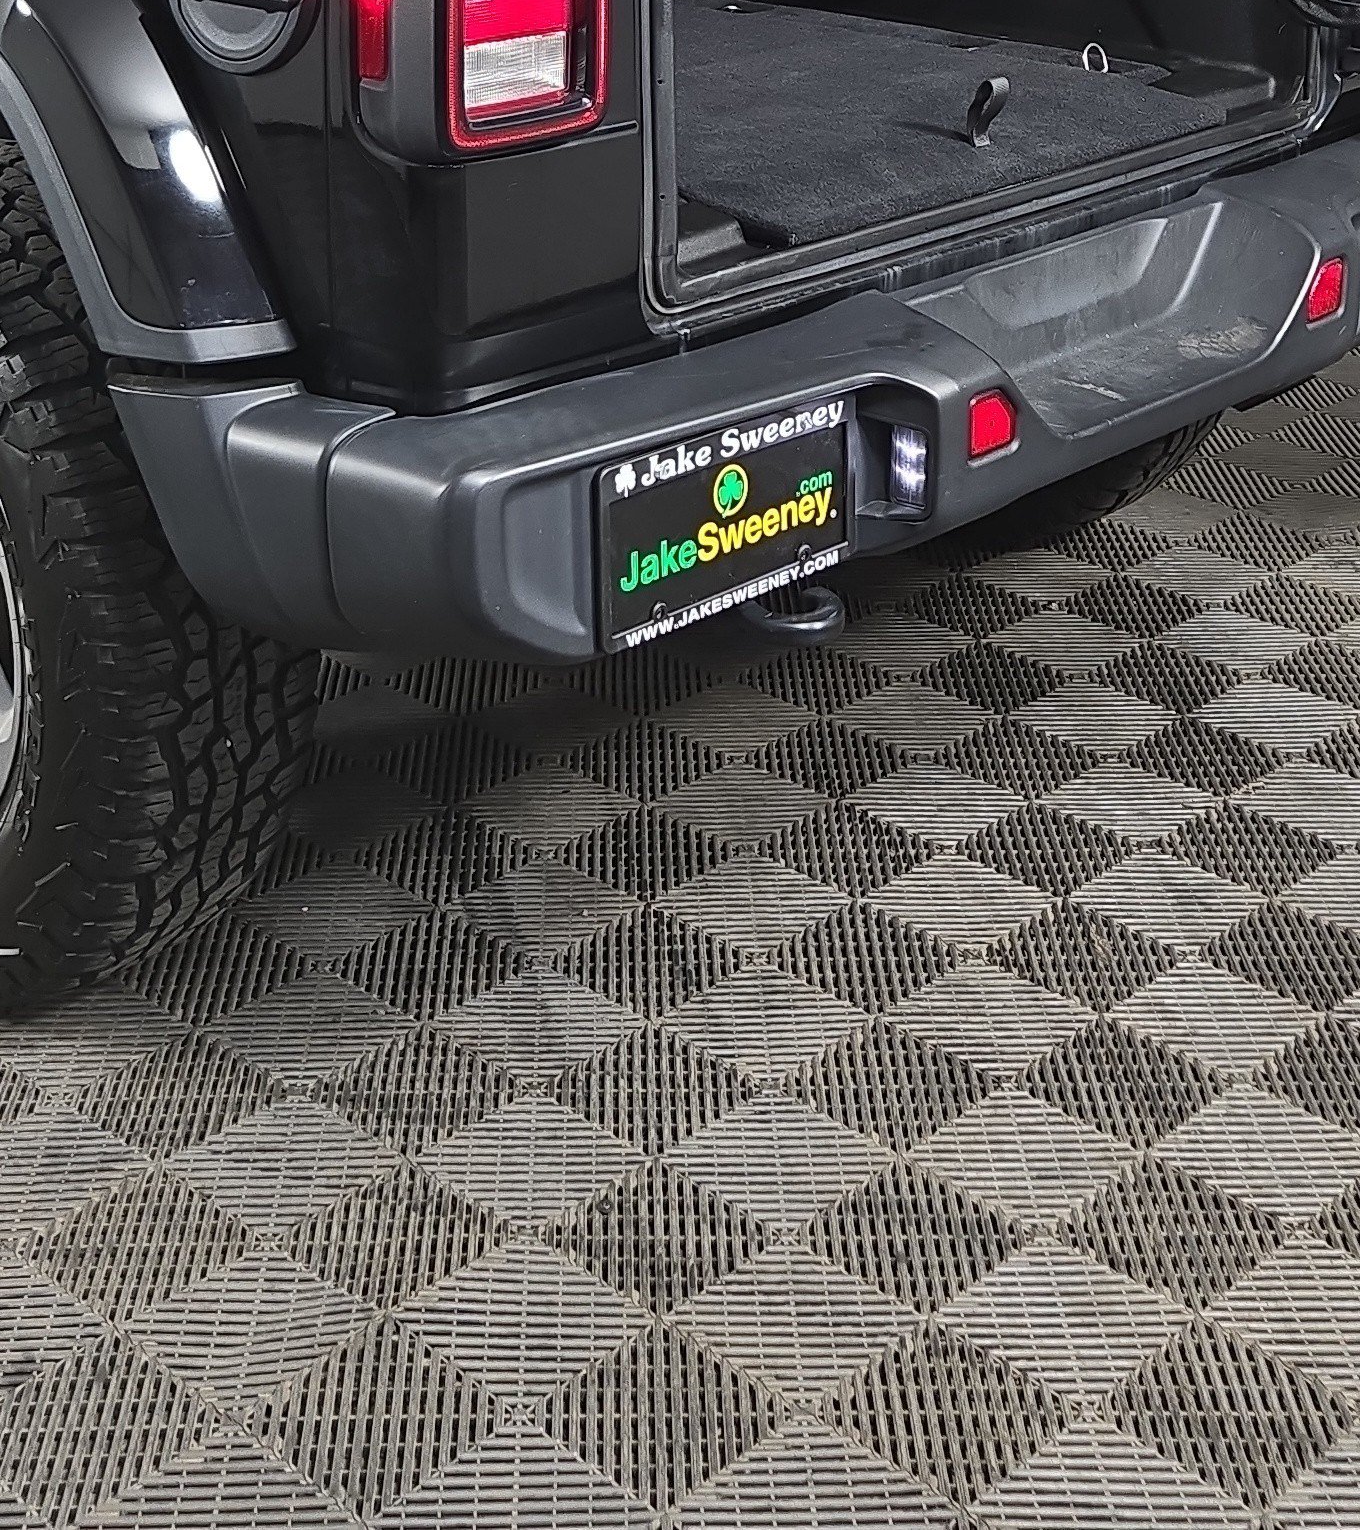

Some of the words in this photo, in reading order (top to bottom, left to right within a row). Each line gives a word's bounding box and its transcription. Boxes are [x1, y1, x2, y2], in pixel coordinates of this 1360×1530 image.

[641, 444, 713, 488] Jake
[720, 400, 844, 458] Sweeney
[625, 550, 839, 647] WWW.JAKESWEENEY.COM
